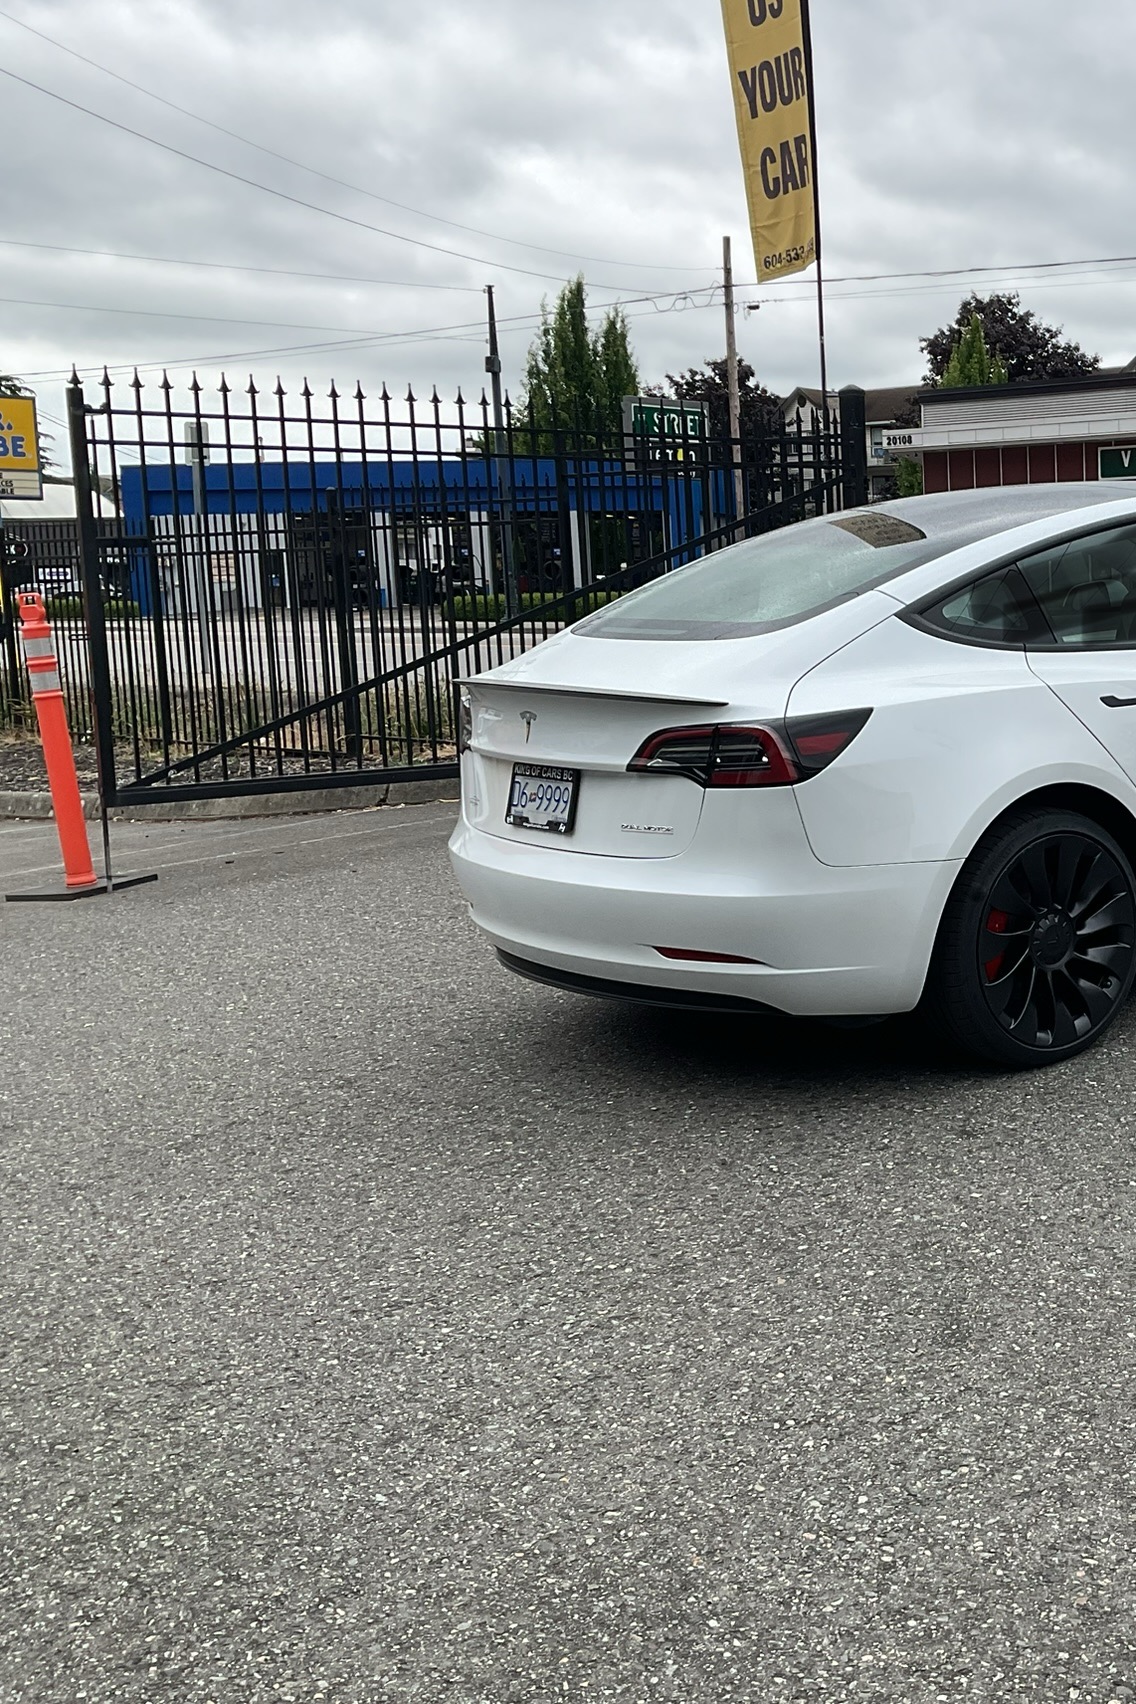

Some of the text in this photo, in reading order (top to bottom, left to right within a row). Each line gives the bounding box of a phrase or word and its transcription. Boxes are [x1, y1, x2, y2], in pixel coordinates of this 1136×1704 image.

[738, 47, 805, 119] YOUR
[760, 133, 810, 200] CAR
[886, 434, 912, 446] 20108
[1120, 450, 1132, 468] V
[514, 763, 574, 781] KING OF CARS BC
